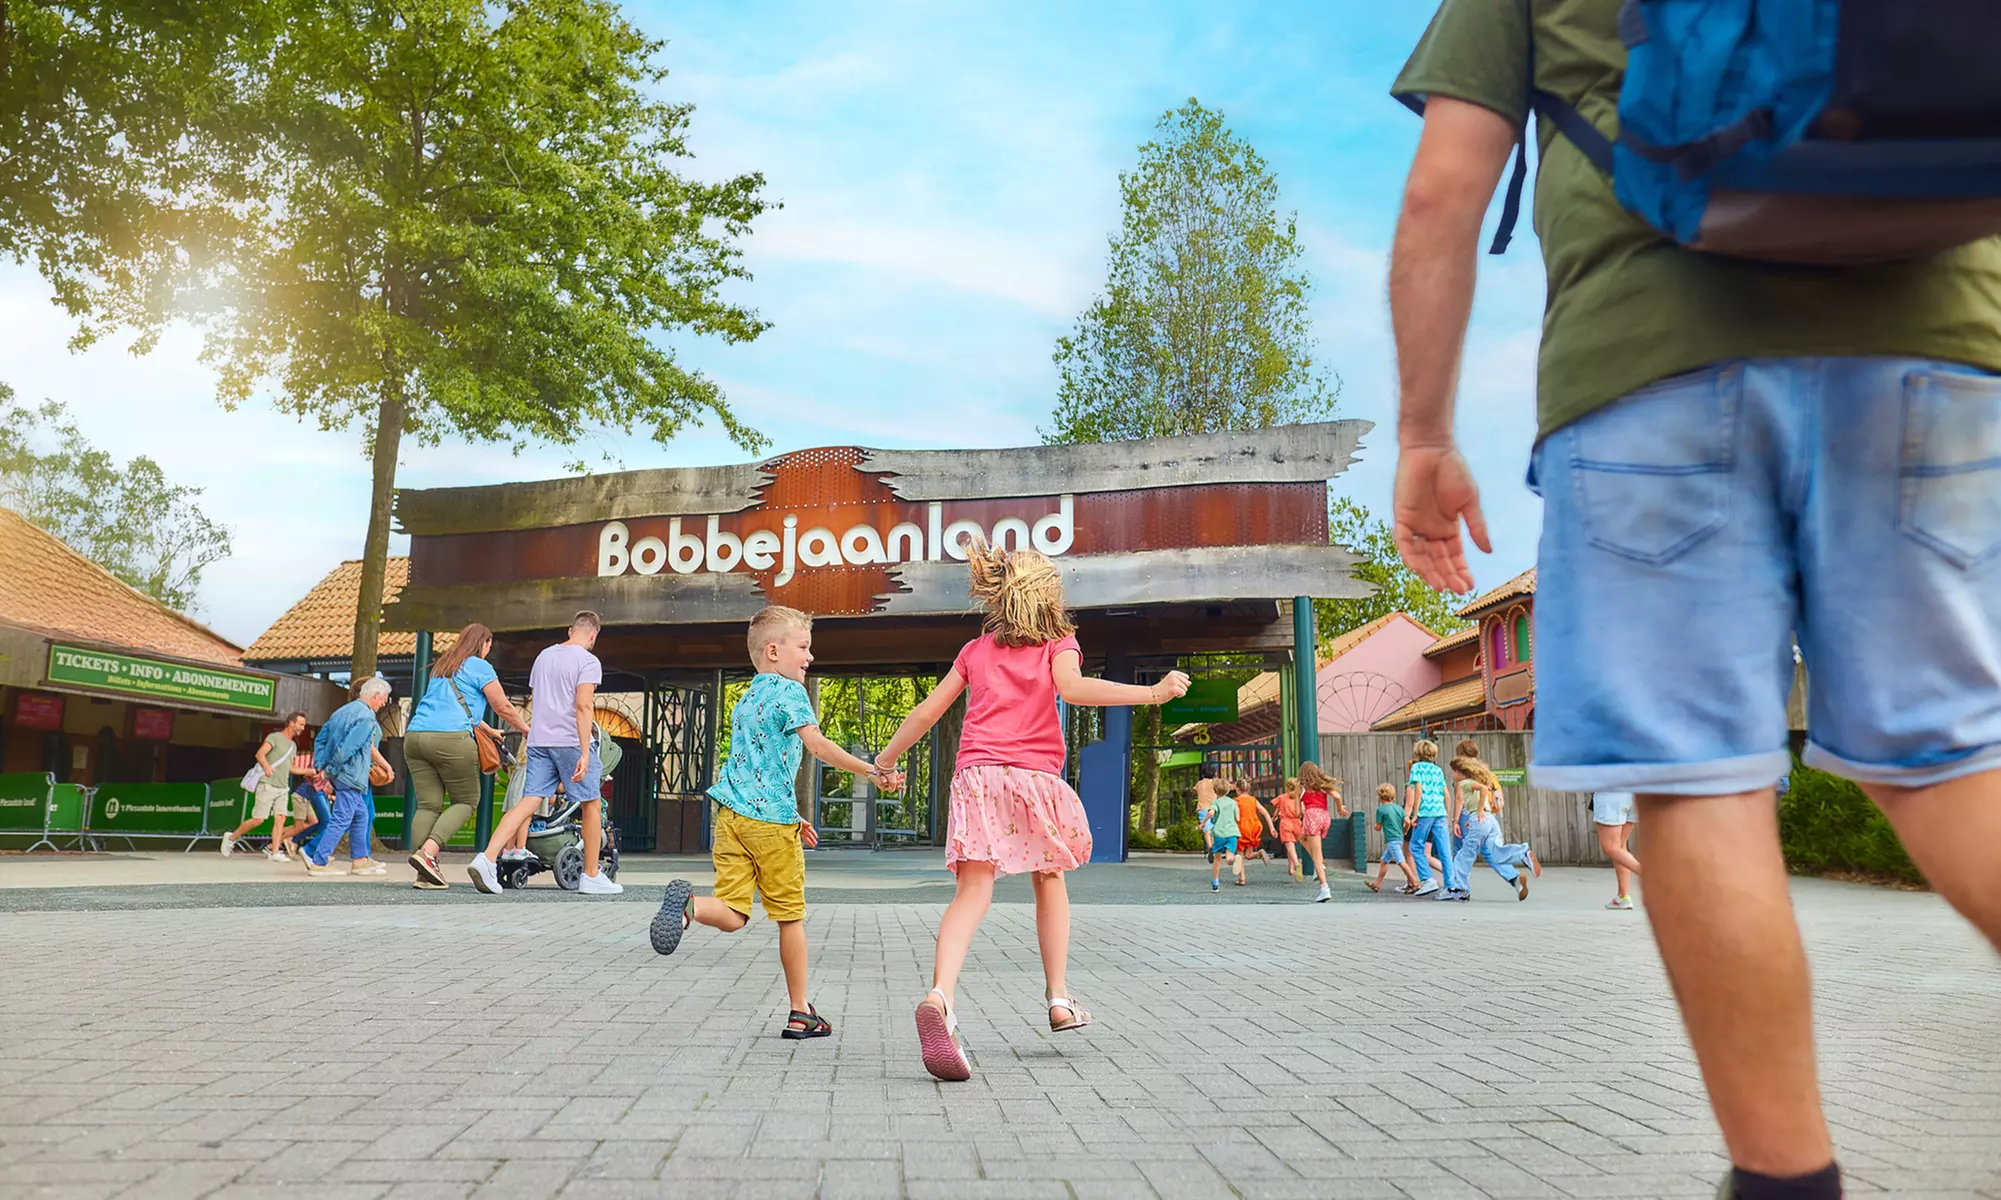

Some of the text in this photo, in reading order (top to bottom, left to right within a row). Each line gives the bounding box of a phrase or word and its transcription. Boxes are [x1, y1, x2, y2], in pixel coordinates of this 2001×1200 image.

[598, 494, 1074, 587] Bobbejaanland
[56, 652, 269, 696] TICKETS INFO ABONNEMENTEN
